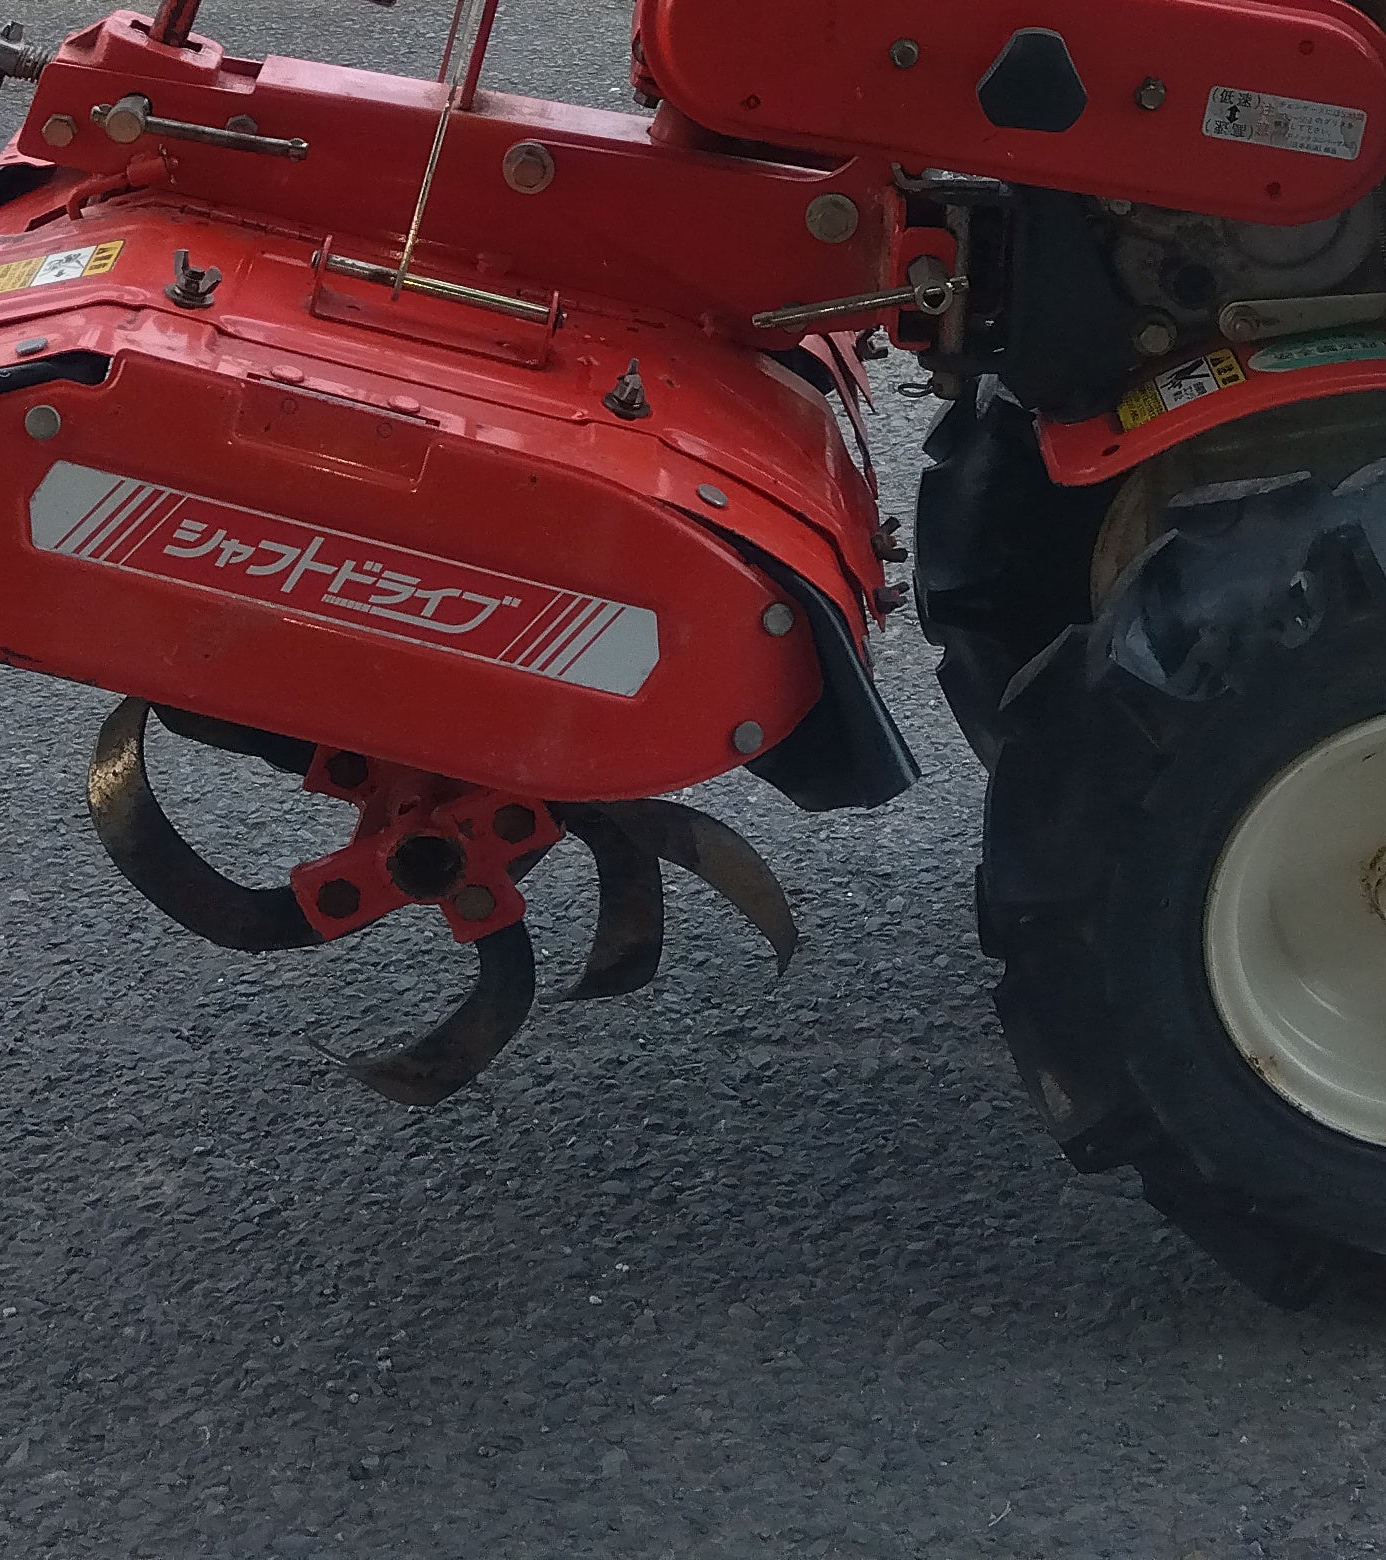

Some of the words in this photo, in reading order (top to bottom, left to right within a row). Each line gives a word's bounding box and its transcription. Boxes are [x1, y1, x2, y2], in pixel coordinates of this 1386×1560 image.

[162, 518, 522, 634] シャフトドライブ
